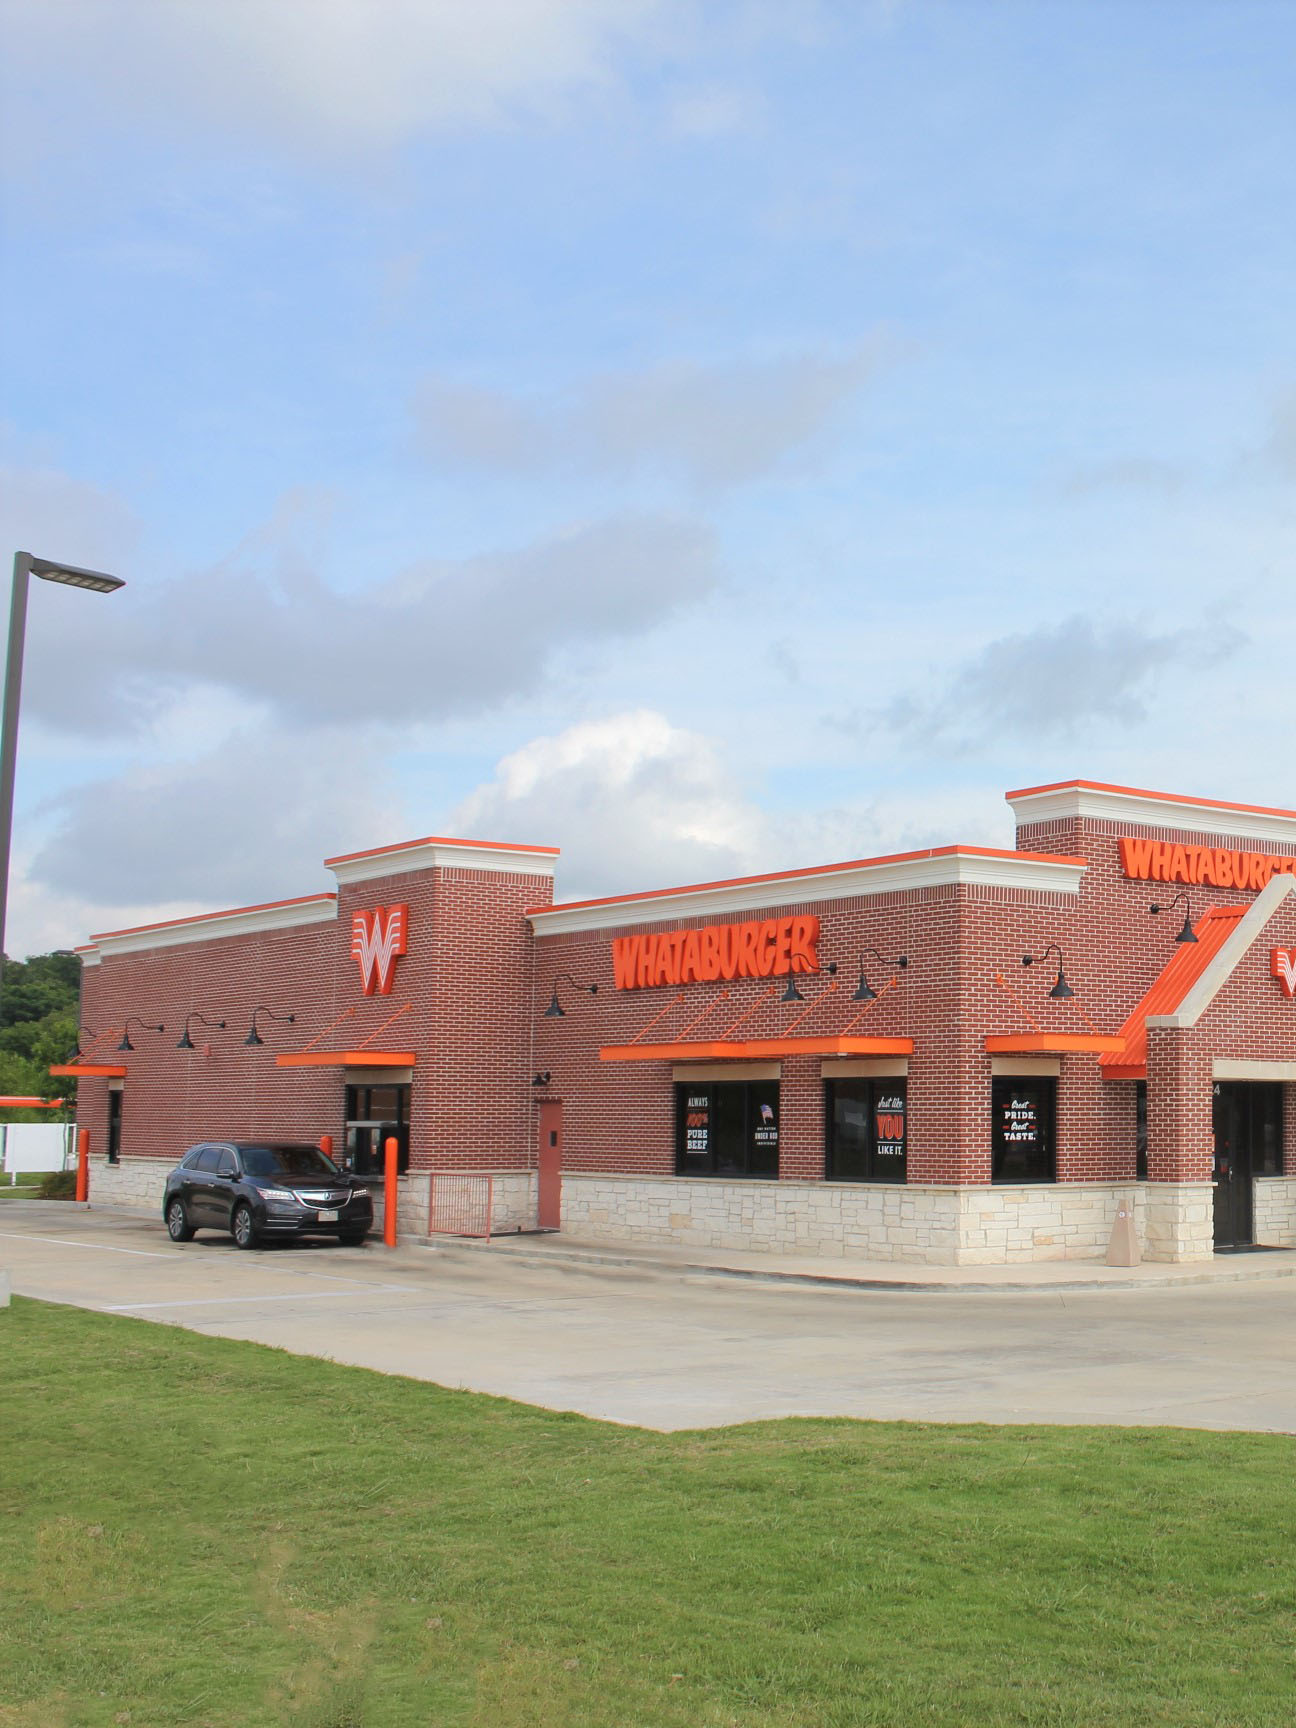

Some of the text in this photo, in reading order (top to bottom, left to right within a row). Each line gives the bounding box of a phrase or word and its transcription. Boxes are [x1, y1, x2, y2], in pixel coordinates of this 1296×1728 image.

[352, 904, 407, 995] W
[613, 914, 820, 990] WHATABURGER
[688, 1097, 708, 1107] ALWAYS
[891, 1097, 903, 1109] like
[1004, 1111, 1037, 1120] PRIDE.
[877, 1114, 903, 1139] YOU
[687, 1129, 708, 1139] PURE
[1003, 1132, 1036, 1141] TASTE.
[687, 1140, 708, 1150] BEEF
[878, 1145, 903, 1156] LIKE IT.
